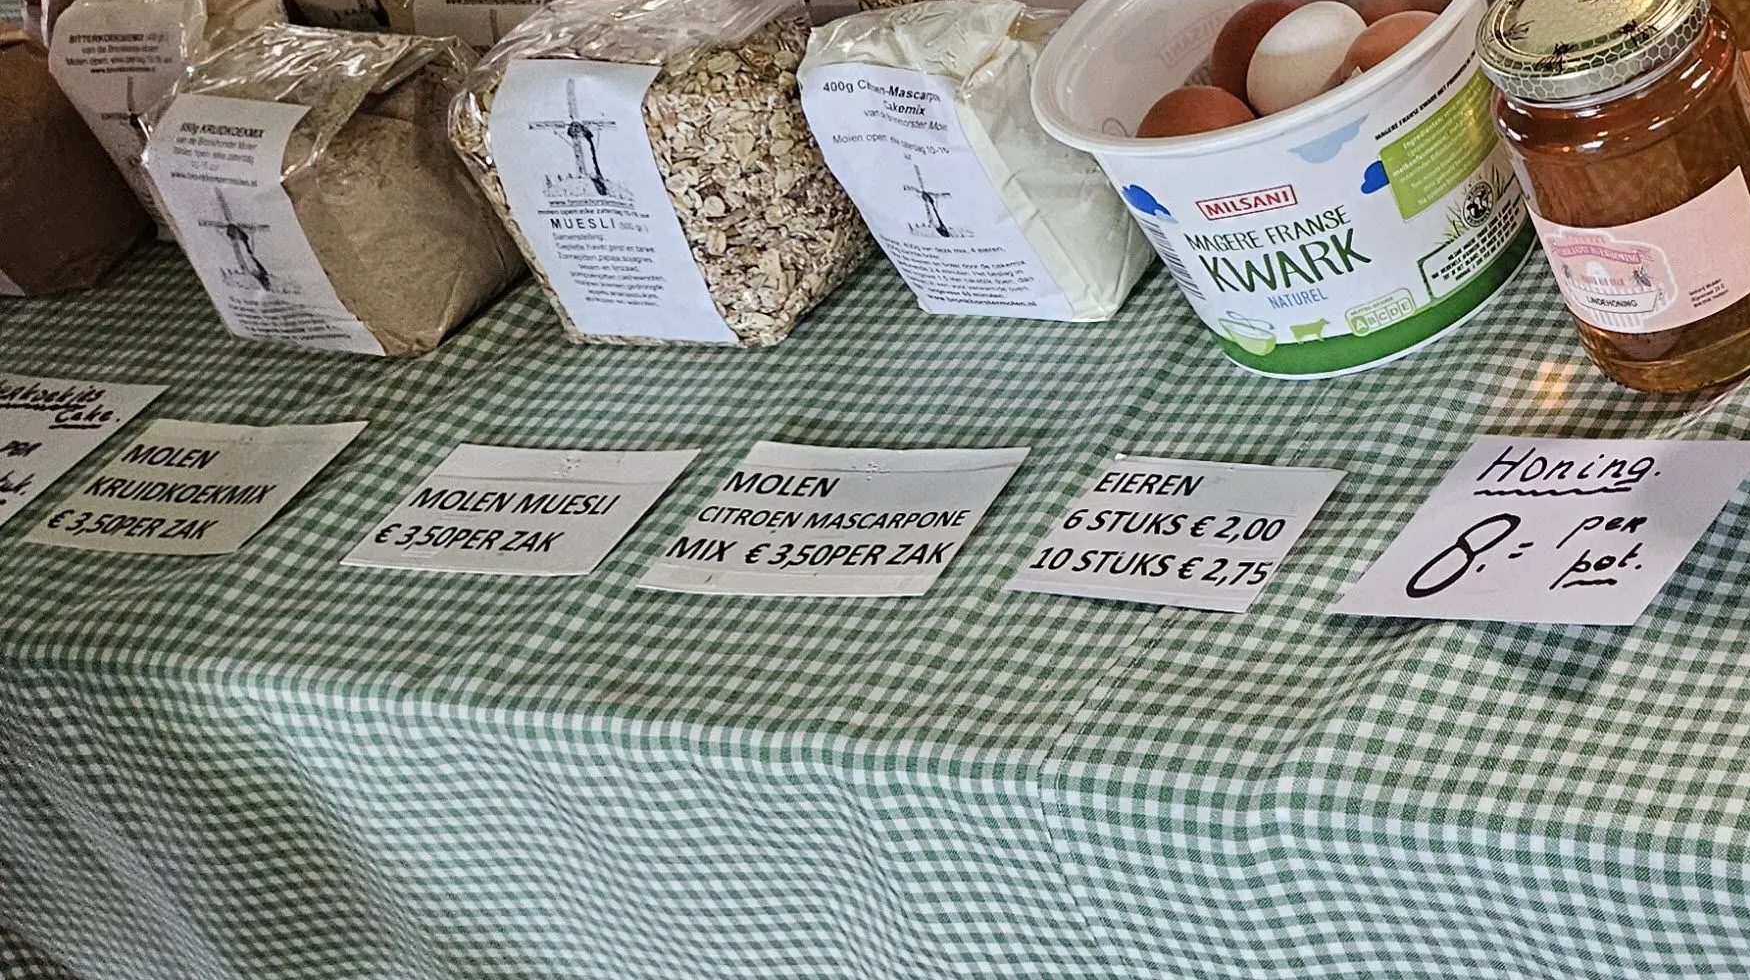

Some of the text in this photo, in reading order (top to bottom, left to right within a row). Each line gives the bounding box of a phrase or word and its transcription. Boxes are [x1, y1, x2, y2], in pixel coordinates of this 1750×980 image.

[822, 80, 854, 94] 400g
[1205, 188, 1291, 217] MILSANI
[550, 218, 616, 230] MUESLI
[1185, 204, 1353, 254] MAGERE FRANSE
[1198, 227, 1373, 293] KWARK
[1267, 286, 1330, 310] NATUREL
[121, 444, 219, 470] MOLEN
[84, 476, 276, 505] KRUIDKOEKMIX
[722, 471, 841, 499] MOLEN
[1094, 471, 1205, 497] EIEREN
[409, 487, 620, 516] MOLEN MUESLI
[48, 509, 76, 529] €
[158, 518, 220, 540] ZAK
[697, 505, 971, 530] CITROEN MASCARPONE
[1062, 508, 1287, 545] 6 STUKS € 2,00
[374, 523, 398, 545] €
[500, 529, 564, 553] ZAK
[1556, 515, 1648, 550] per
[665, 536, 737, 562] MIX
[744, 539, 769, 565] €
[884, 541, 956, 567] ZAK
[1029, 545, 1271, 588] 10 STUKS € 2,75
